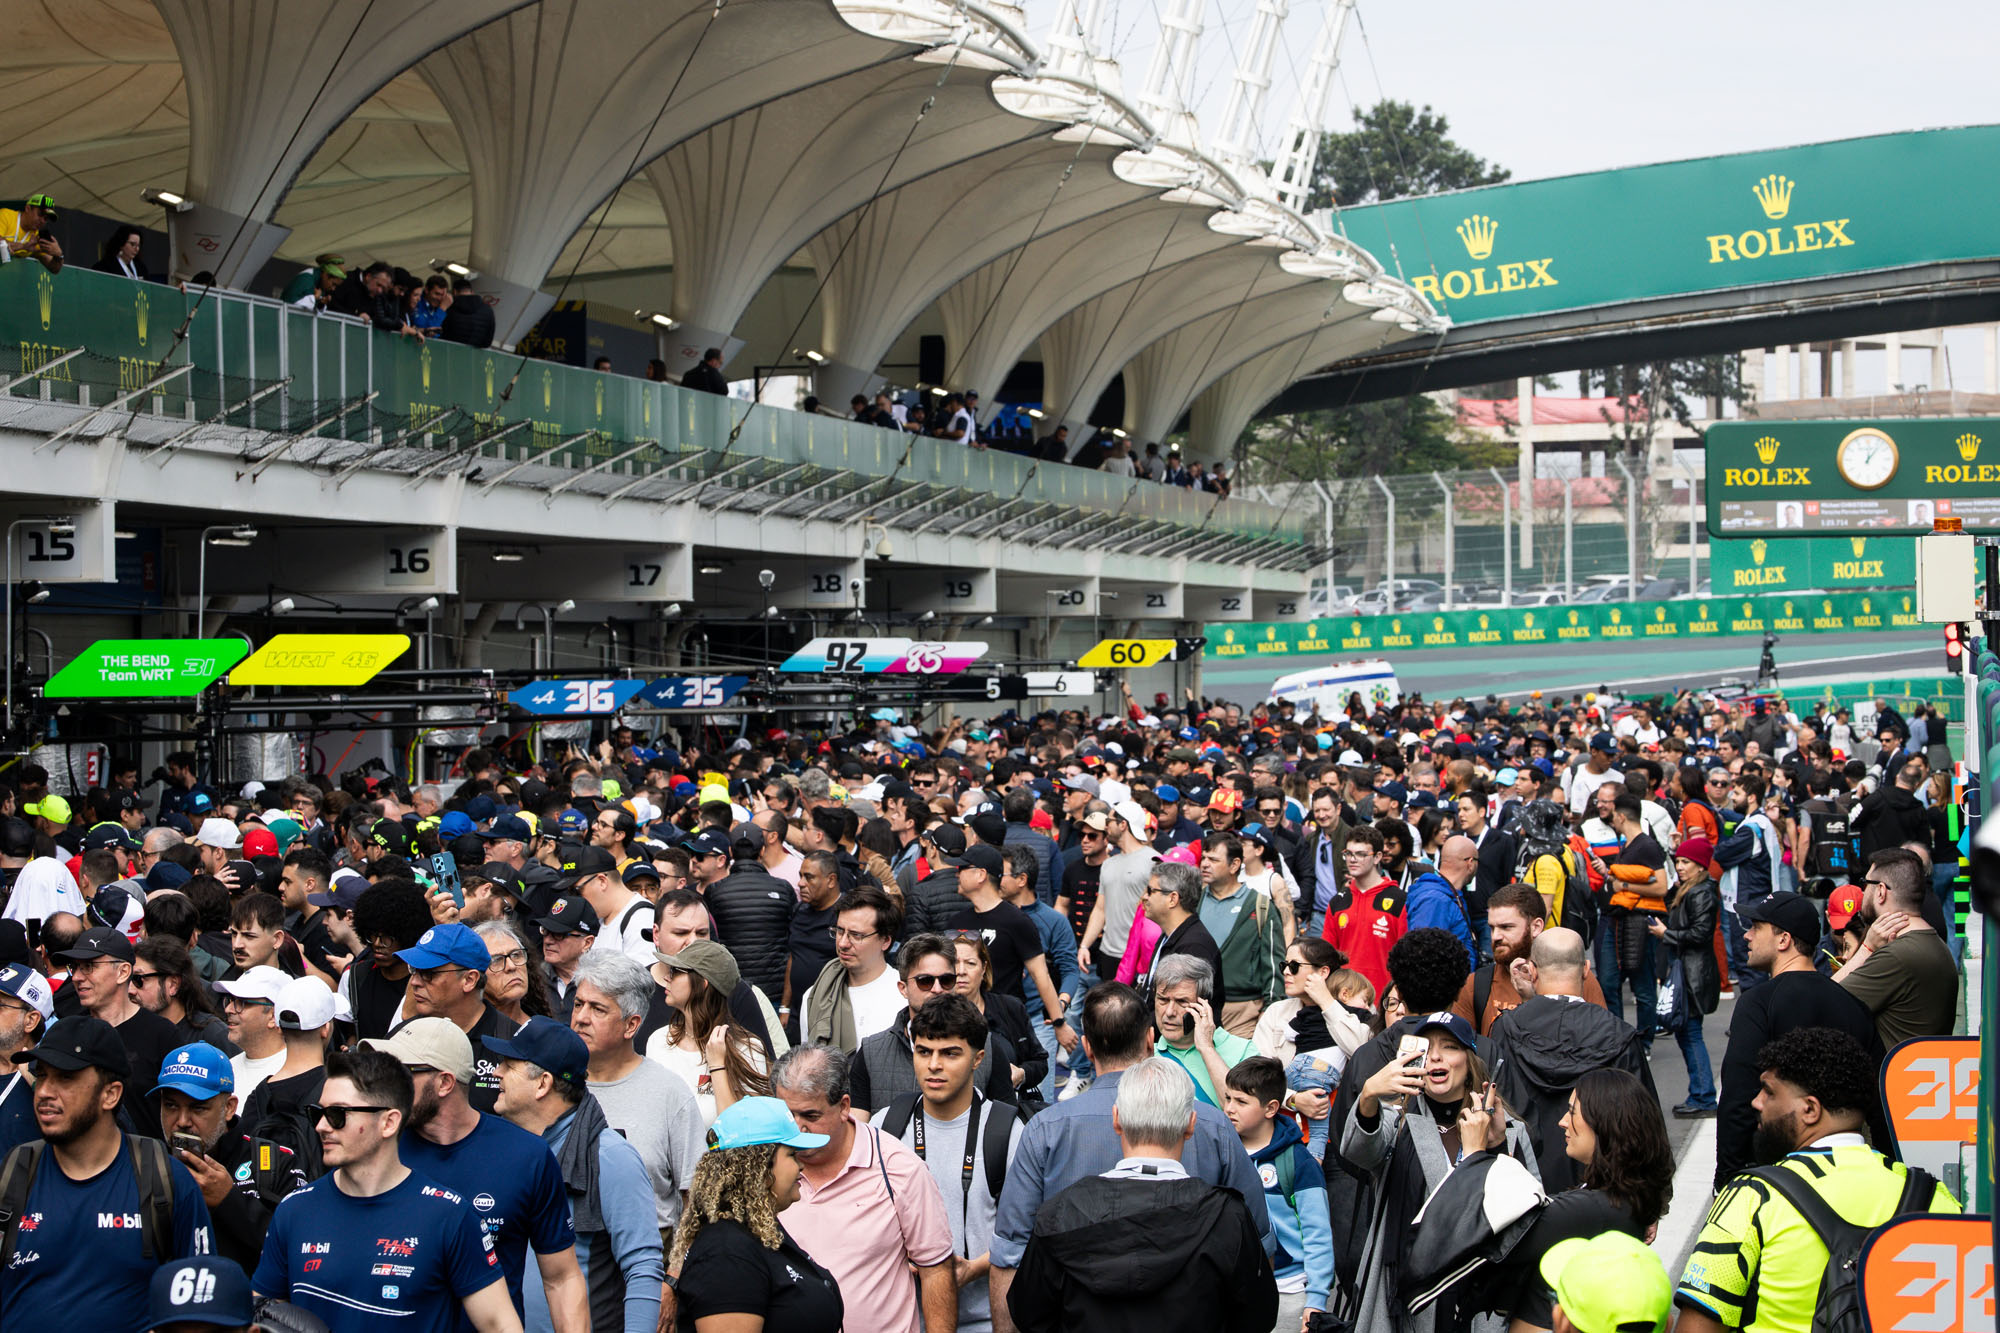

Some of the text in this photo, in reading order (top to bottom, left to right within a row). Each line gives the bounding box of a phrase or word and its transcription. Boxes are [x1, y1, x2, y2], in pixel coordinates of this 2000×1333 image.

[1707, 218, 1855, 263] ROLEX
[1412, 258, 1558, 301] ROLEX
[20, 341, 72, 382] ROLEX
[410, 402, 444, 435] ROLEX
[1724, 467, 1811, 486] ROLEX
[1925, 464, 2000, 483] ROLE
[28, 531, 75, 562] 15
[389, 547, 430, 574] 16
[628, 564, 662, 587] 17
[1734, 567, 1786, 586] ROLEX
[1833, 560, 1885, 579] ROLEX
[812, 574, 842, 593] 18
[946, 581, 973, 599] 19
[1058, 589, 1085, 606] 20
[1146, 593, 1167, 608] 21
[1221, 598, 1241, 611] 22
[1277, 603, 1296, 615] 23
[1689, 621, 1719, 632] ROLEX
[1732, 619, 1764, 631] ROLEX
[1774, 618, 1804, 629] ROLEX
[1813, 617, 1844, 628] ROLEX
[1853, 615, 1882, 627] ROLEX
[1892, 614, 1917, 626] ROLE
[1468, 631, 1502, 642] ROLEX
[1513, 629, 1546, 640] ROLEX
[1558, 626, 1590, 638] ROLEX
[1601, 625, 1633, 636] ROLEX
[1645, 623, 1677, 635] ROLEX
[1298, 639, 1330, 650] ROLEX
[1342, 637, 1372, 649] ROLEX
[1383, 635, 1413, 646] ROLEX
[1424, 633, 1456, 644] ROLEX
[1111, 643, 1146, 664] 60
[1216, 644, 1246, 656] ROLEX
[1257, 641, 1288, 653] ROLEX
[101, 655, 170, 667] THE BEND
[264, 651, 379, 668] WRT 46
[824, 643, 868, 673] 92
[906, 644, 946, 674] 85
[181, 658, 216, 676] 31
[98, 669, 174, 681] Team WRT
[986, 678, 1000, 699] 5
[1056, 674, 1067, 692] 6
[563, 681, 614, 712] 36
[682, 678, 723, 706] 35
[162, 1065, 206, 1077] NACIONAL
[421, 1186, 461, 1205] Mobil
[98, 1213, 142, 1228] Mobil
[301, 1242, 330, 1254] Mobil
[376, 1238, 406, 1247] FULL
[384, 1246, 415, 1255] TIME
[170, 1267, 216, 1305] 6h
[193, 1295, 214, 1303] SP
